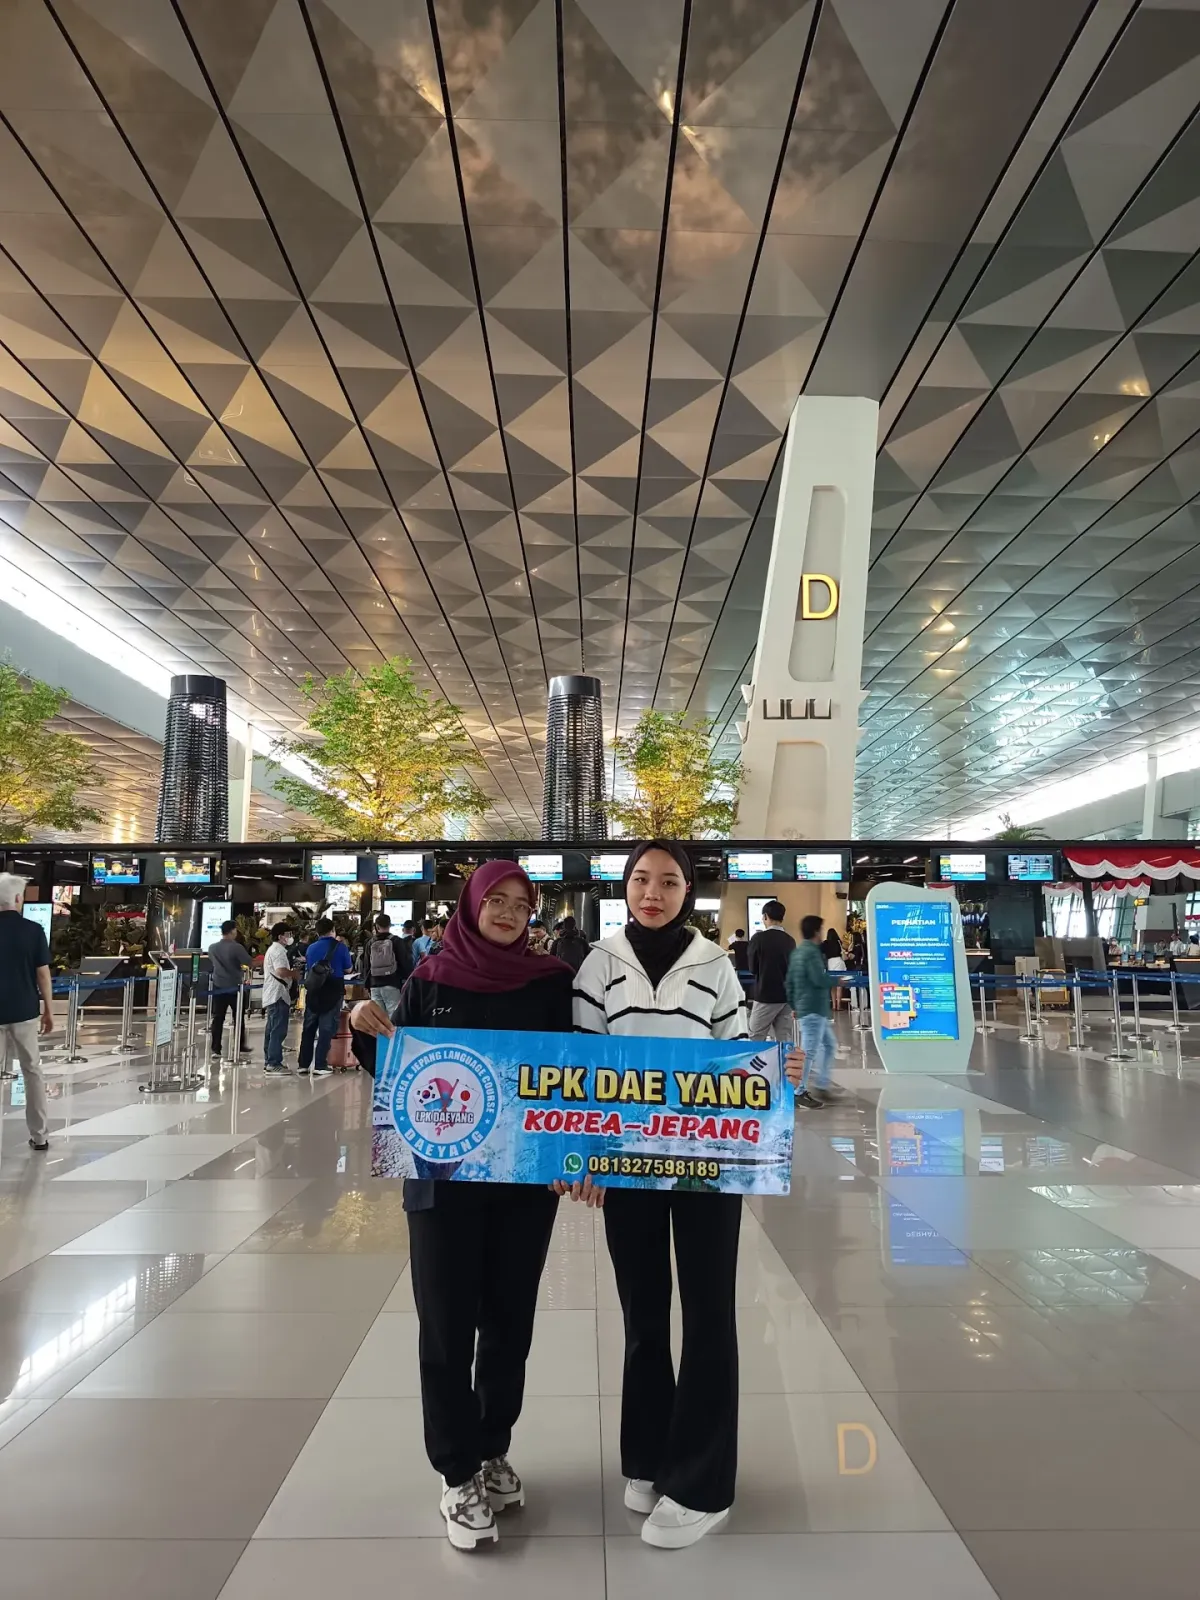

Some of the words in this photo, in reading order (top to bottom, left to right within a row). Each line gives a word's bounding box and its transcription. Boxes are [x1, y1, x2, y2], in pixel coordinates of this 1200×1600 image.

[802, 573, 839, 620] D
[395, 1080, 409, 1111] KOREA
[410, 1051, 442, 1074] JEPANG
[443, 1050, 486, 1077] LANGUAGE
[481, 1075, 496, 1114] COURSE
[518, 1065, 588, 1099] LPK
[596, 1067, 666, 1103] DAE
[675, 1071, 771, 1110] YANG
[415, 1110, 433, 1123] LPK
[433, 1111, 475, 1124] DAEYANG
[404, 1127, 484, 1157] DAEYANG
[588, 1156, 720, 1178] 081327598189
